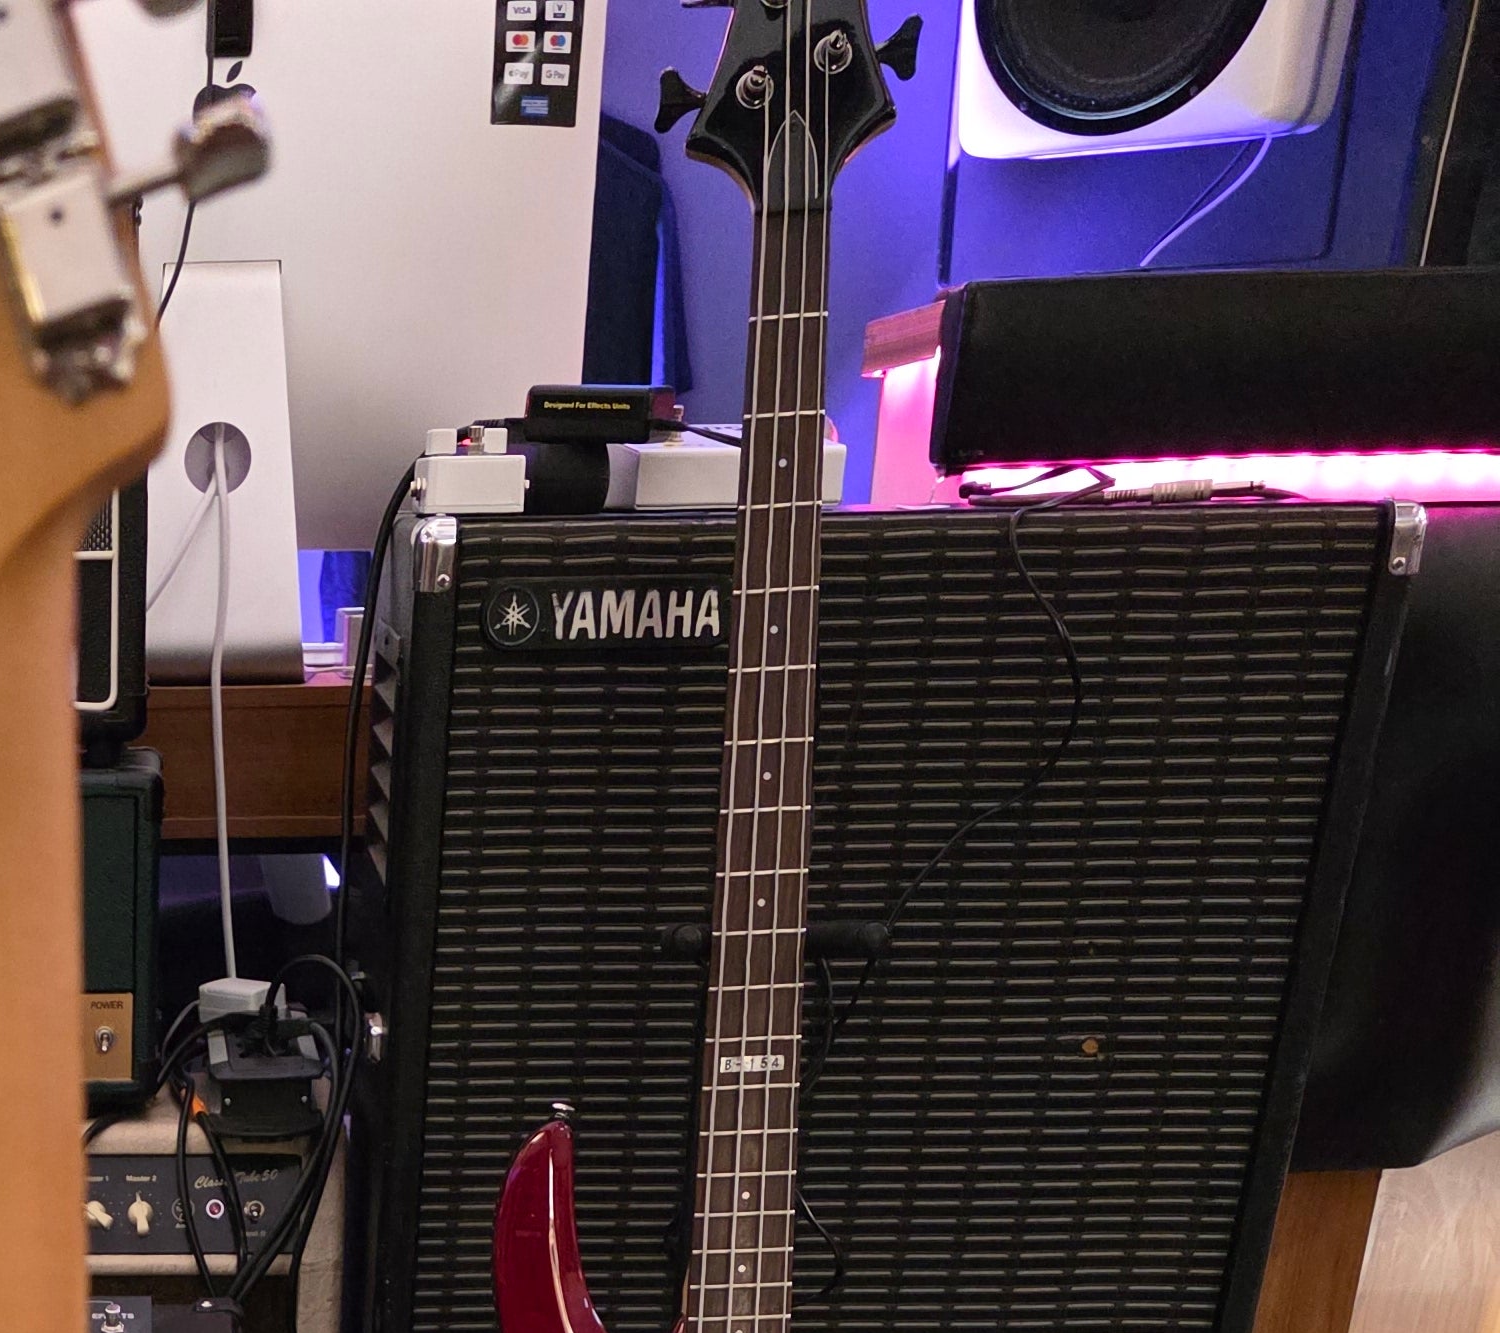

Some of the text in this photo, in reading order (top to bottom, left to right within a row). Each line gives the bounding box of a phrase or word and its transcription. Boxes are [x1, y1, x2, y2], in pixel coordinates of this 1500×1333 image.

[513, 6, 532, 14] VISA
[543, 401, 575, 410] Designed
[586, 402, 612, 410] Effects
[612, 402, 631, 410] Units
[551, 589, 720, 640] YAMAHA
[90, 1000, 124, 1010] POWER
